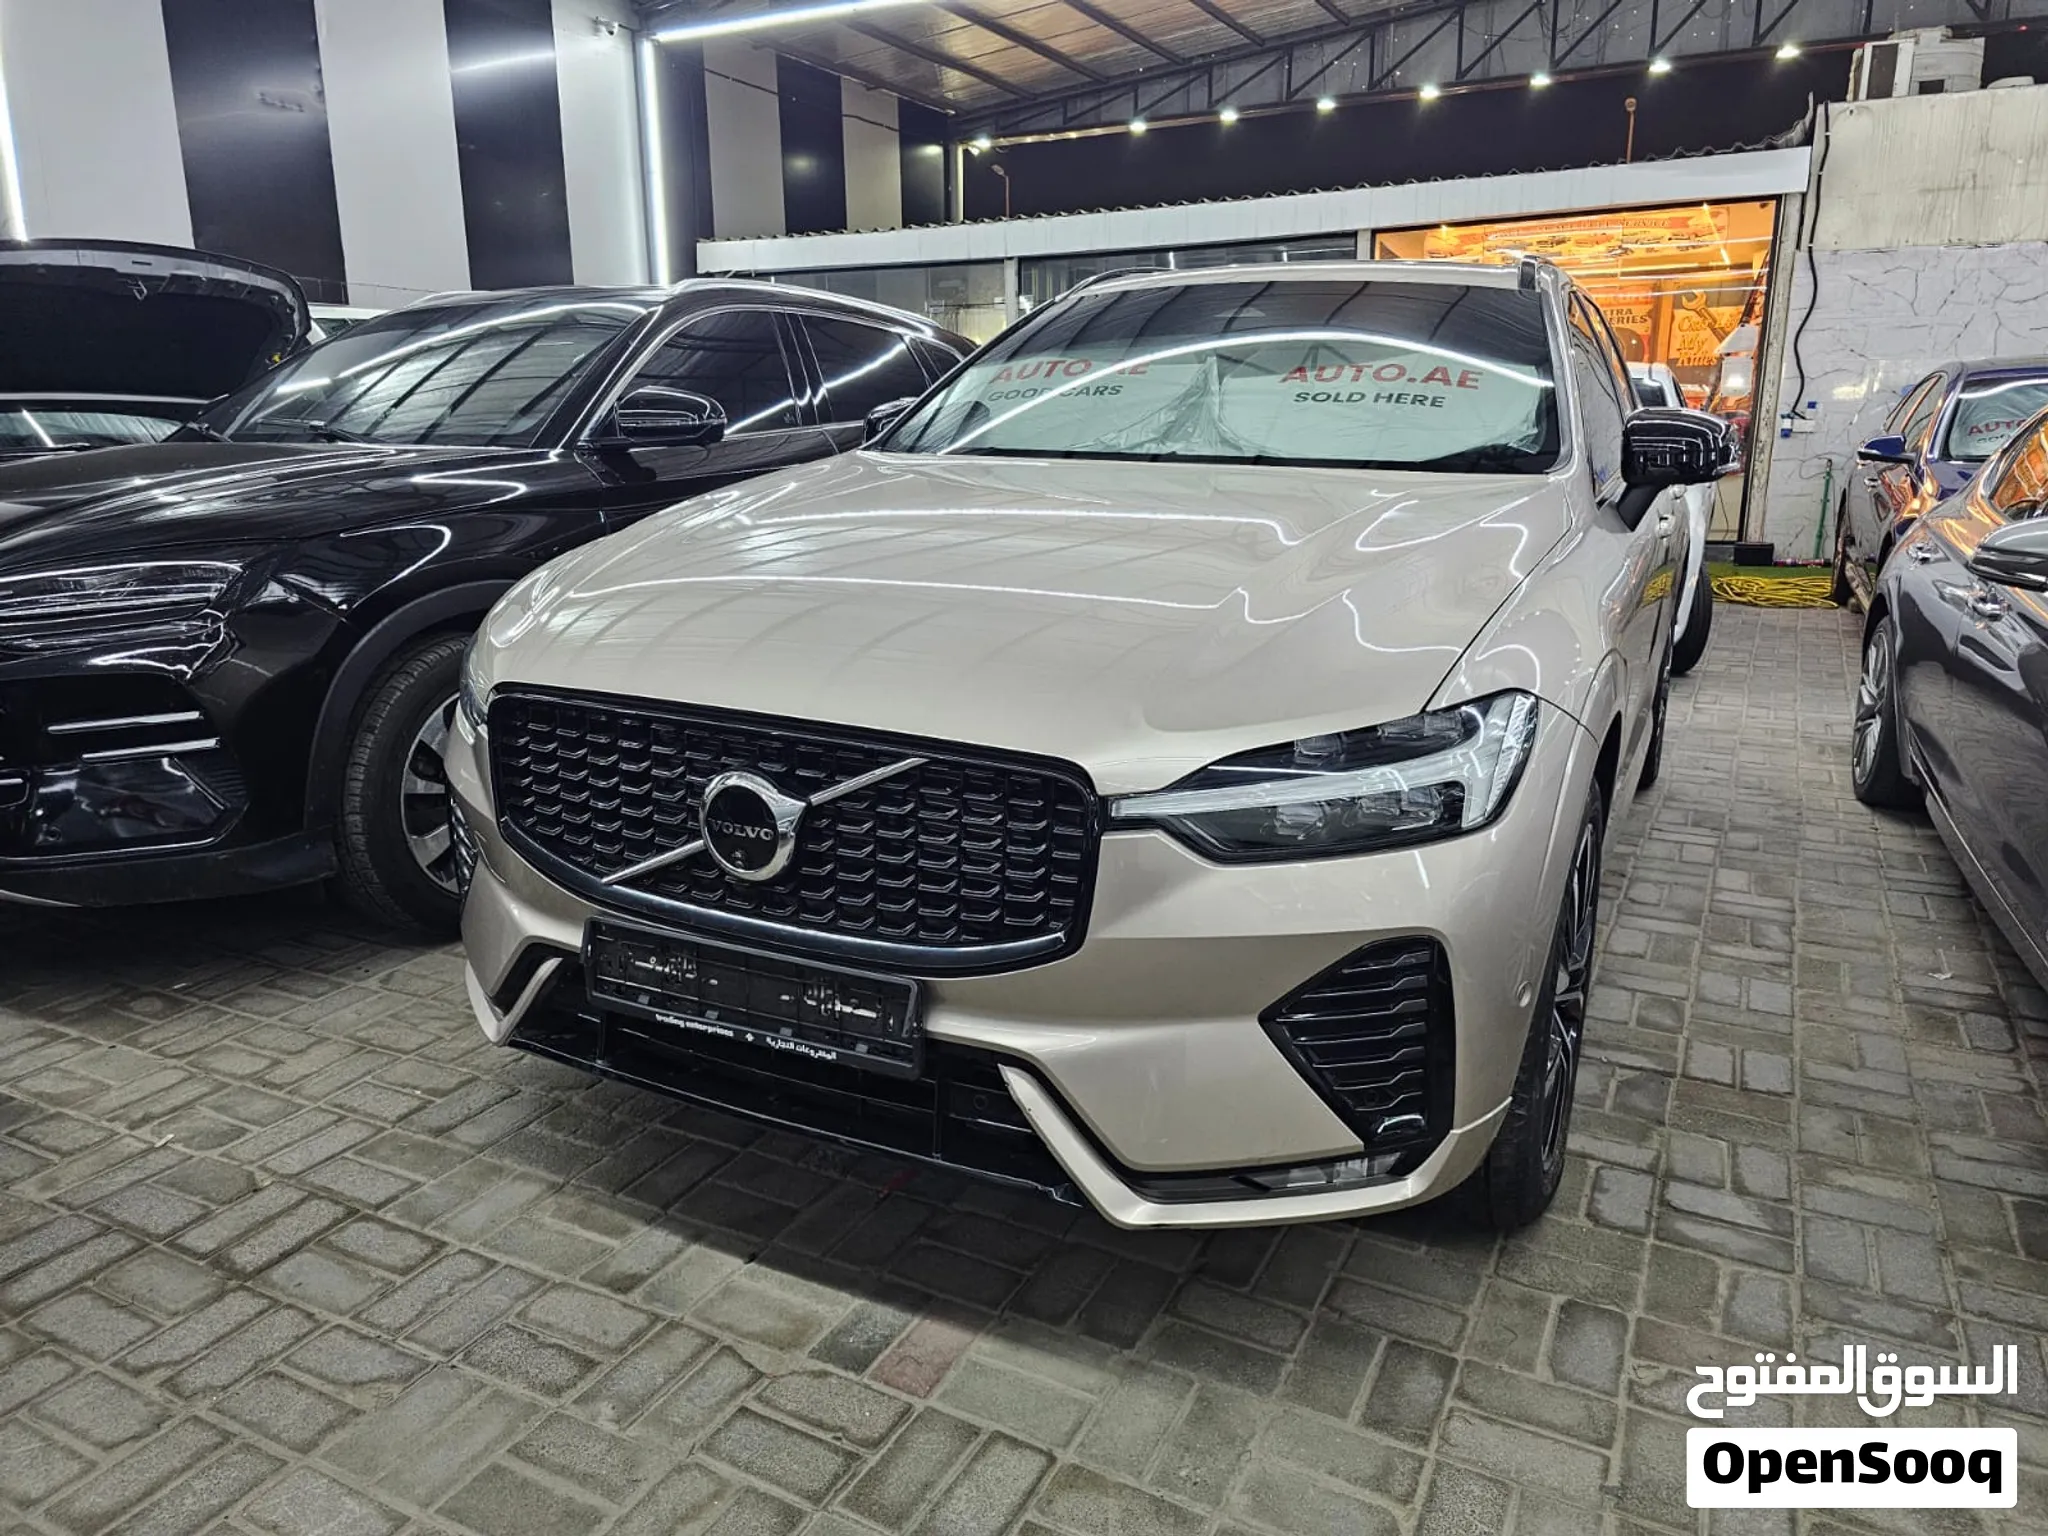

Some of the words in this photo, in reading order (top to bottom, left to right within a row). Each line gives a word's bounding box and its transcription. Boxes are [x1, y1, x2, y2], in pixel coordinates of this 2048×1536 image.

[1279, 363, 1483, 390] AUTO.AE
[1293, 391, 1366, 403] SOLD
[1372, 392, 1446, 408] HERE
[707, 818, 774, 840] VOLVO
[655, 1014, 685, 1028] trading
[686, 1021, 734, 1037] enterprises
